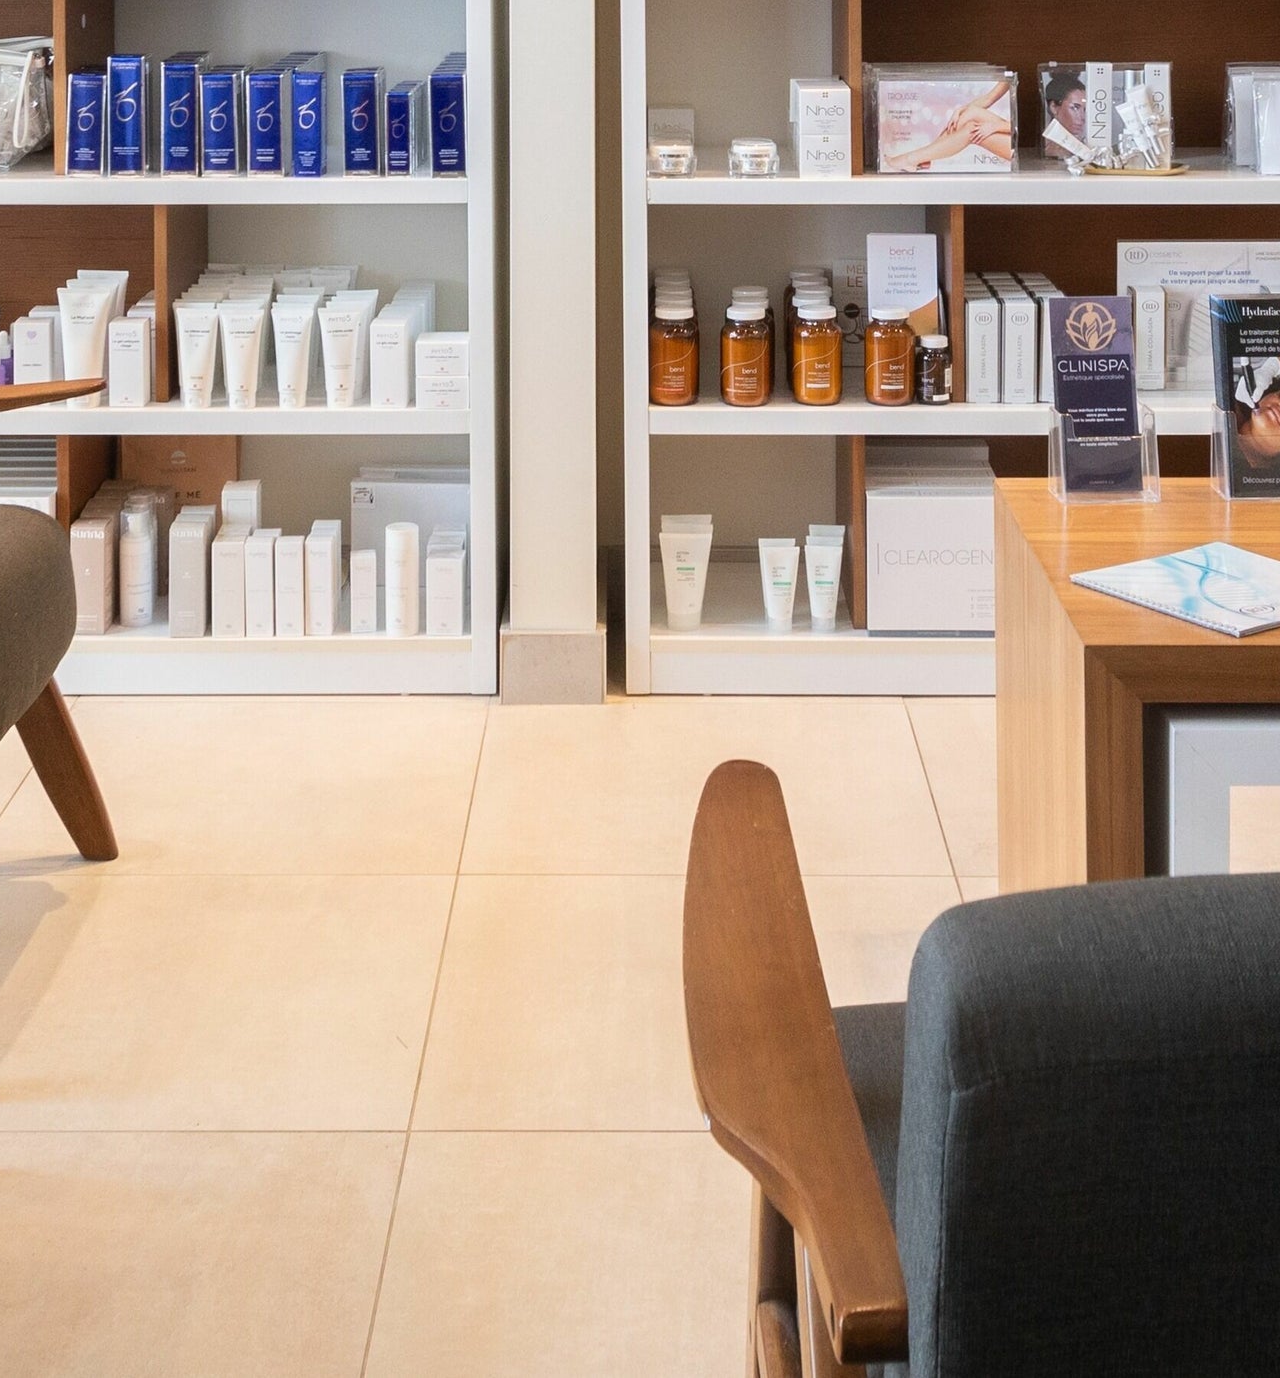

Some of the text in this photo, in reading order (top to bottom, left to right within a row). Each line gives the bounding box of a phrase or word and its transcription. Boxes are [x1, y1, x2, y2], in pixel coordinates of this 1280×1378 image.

[889, 246, 915, 256] bend
[1237, 277, 1259, 285] derme
[1249, 329, 1279, 337] traitement
[1240, 337, 1246, 345] la
[1247, 337, 1264, 345] santé
[1265, 337, 1272, 345] de
[1273, 337, 1279, 345] la
[1267, 345, 1276, 354] de
[1057, 358, 1130, 373] CLINISPA
[1243, 476, 1275, 485] Découvrez
[884, 549, 994, 566] CLEAROGEN
